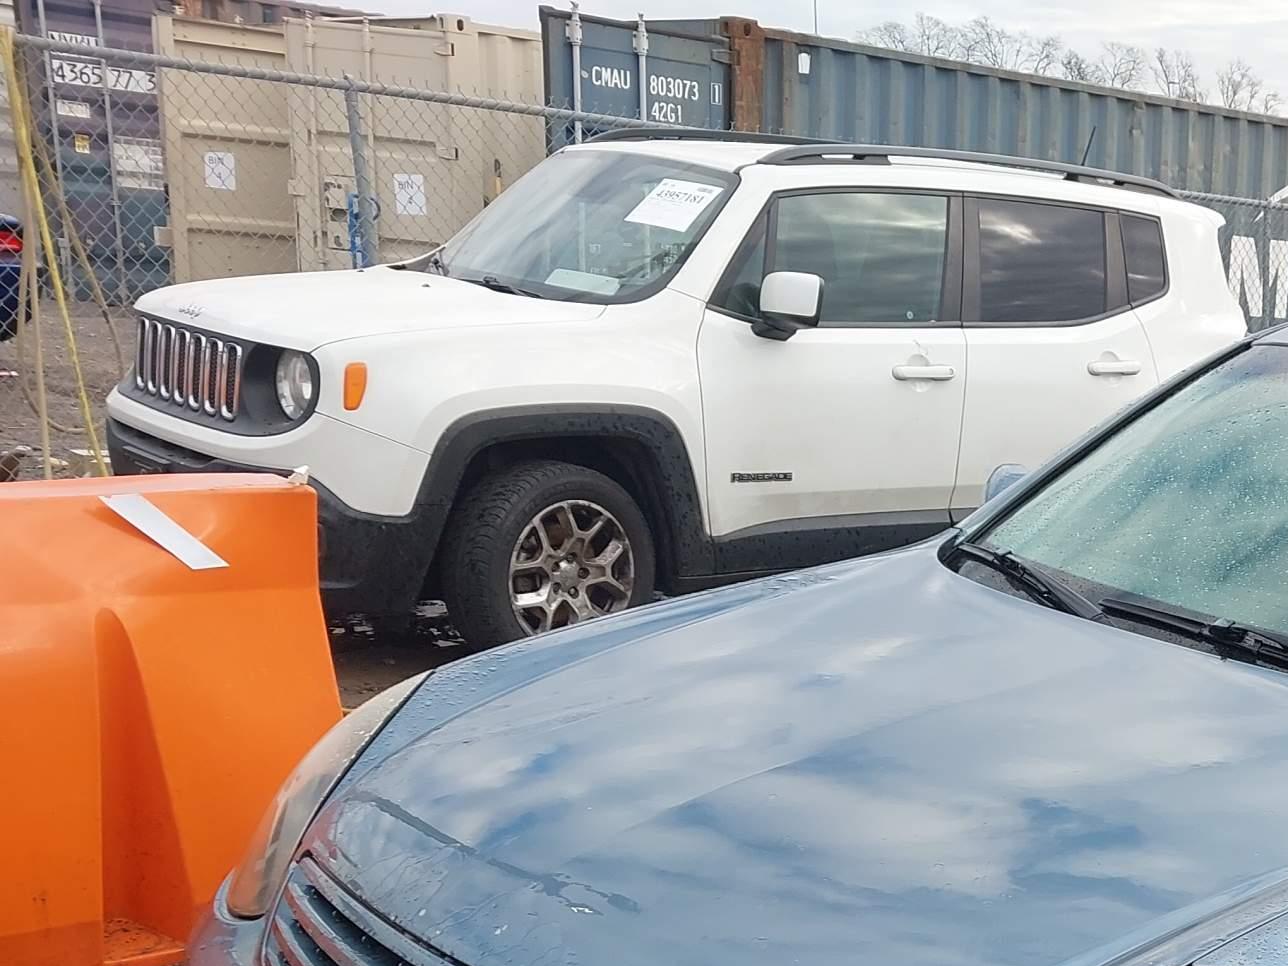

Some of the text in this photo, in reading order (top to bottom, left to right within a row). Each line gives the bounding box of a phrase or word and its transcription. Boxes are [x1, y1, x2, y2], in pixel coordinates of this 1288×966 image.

[54, 62, 102, 85] 4365
[591, 65, 631, 89] CMAU
[649, 74, 699, 101] 803073
[651, 101, 682, 123] 42G1
[730, 472, 793, 483] RENEGADE
